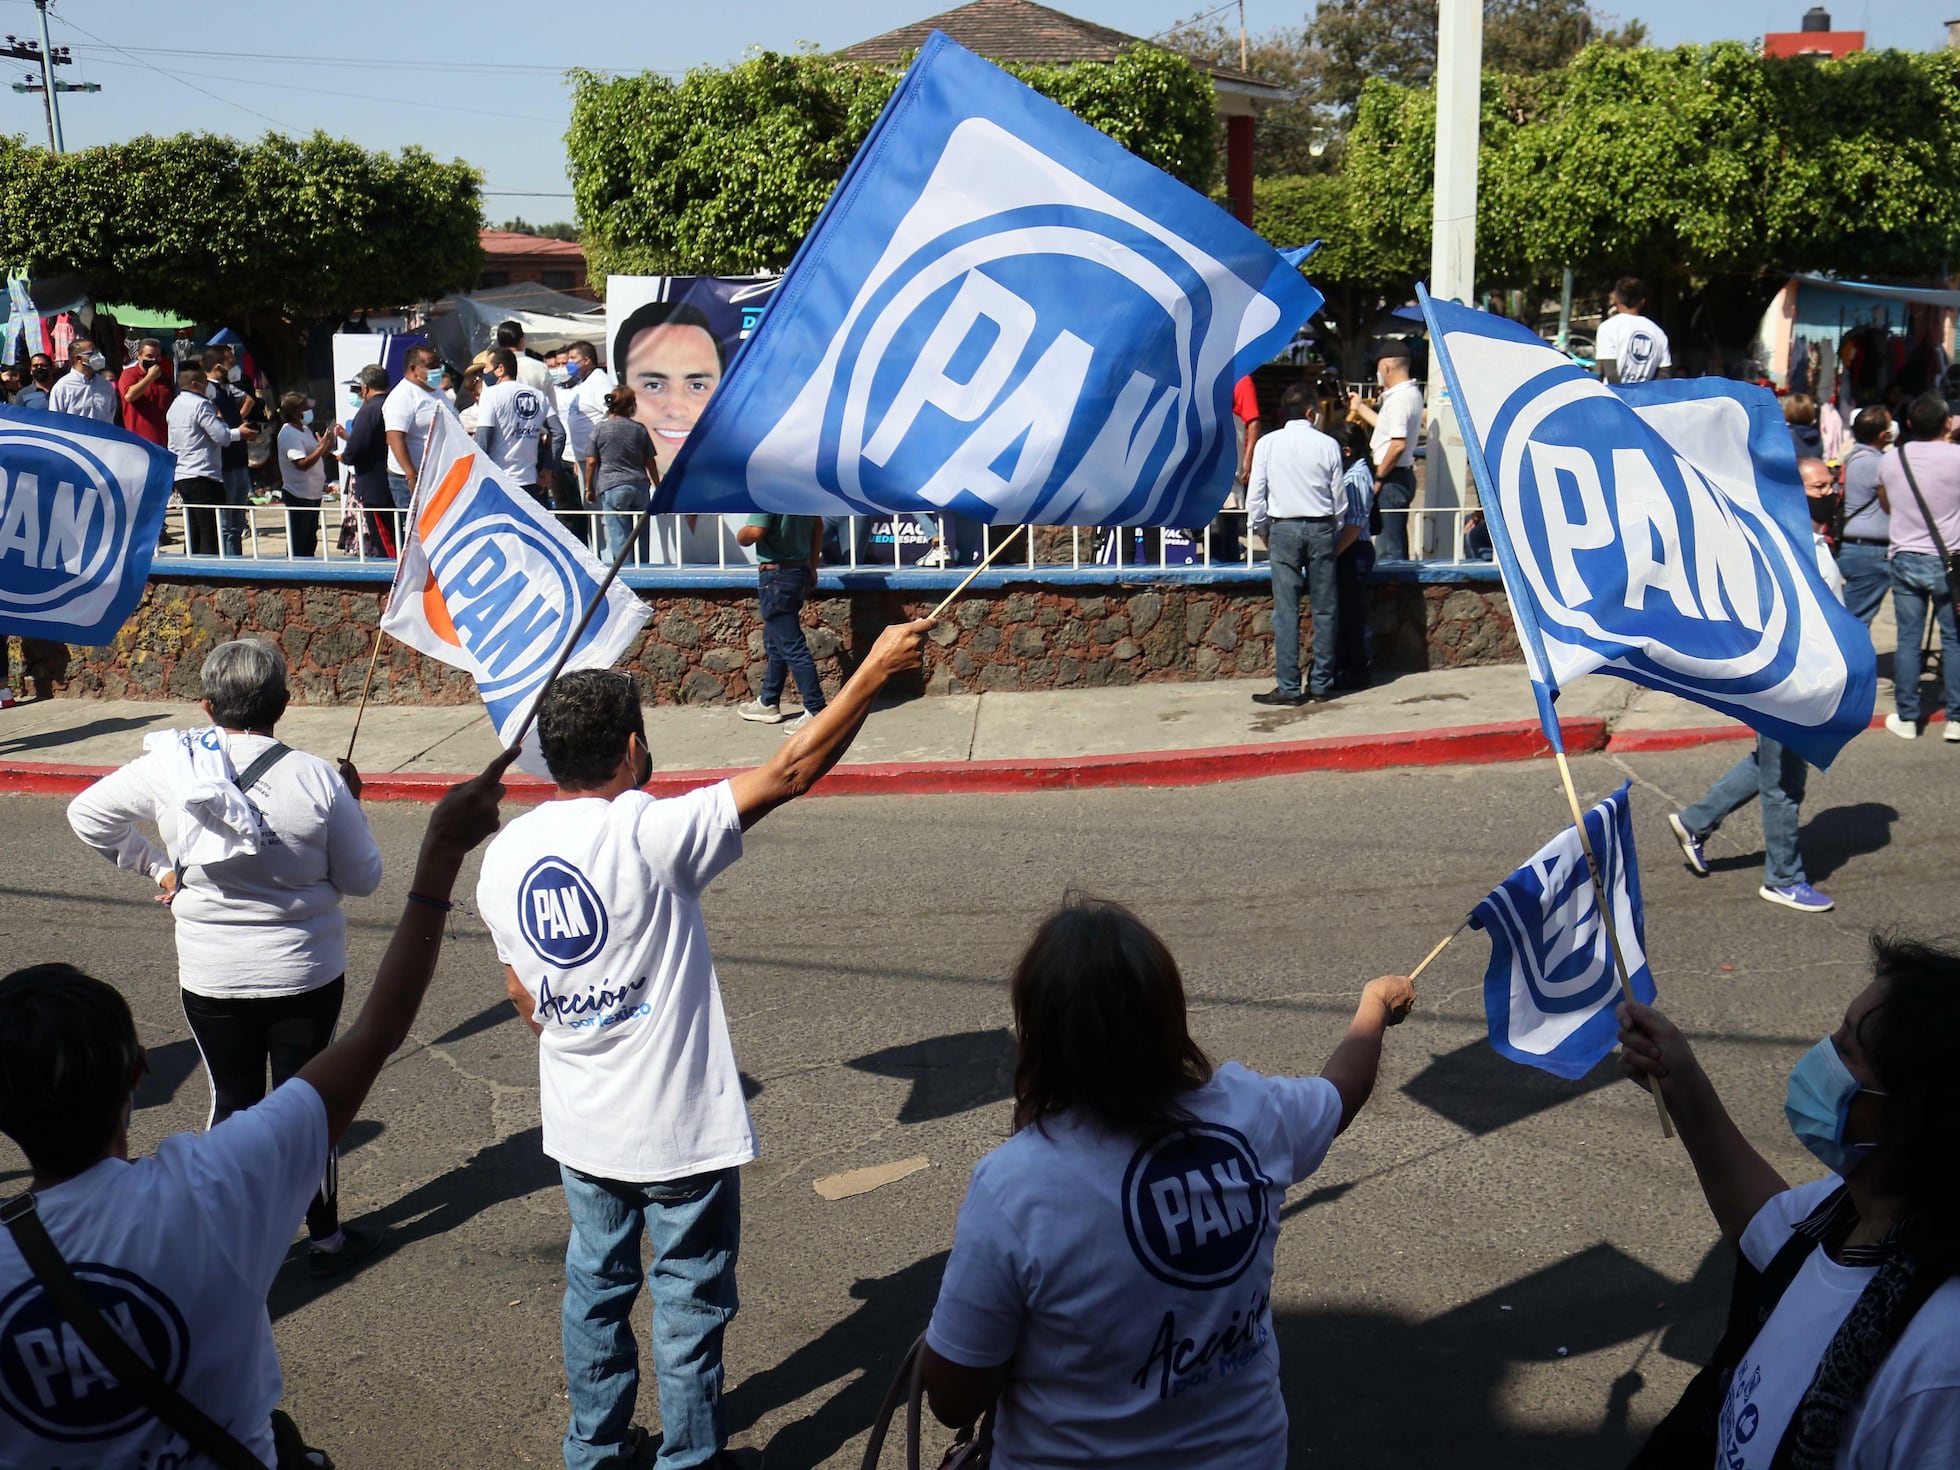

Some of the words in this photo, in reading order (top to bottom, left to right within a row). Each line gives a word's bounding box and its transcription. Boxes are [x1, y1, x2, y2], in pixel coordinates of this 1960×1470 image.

[860, 267, 1181, 526] PAN
[1527, 439, 1764, 633] PAN
[441, 537, 561, 680] PAN
[532, 885, 591, 940] PAN
[539, 974, 647, 1026] Acción
[1149, 1157, 1254, 1257] PAN
